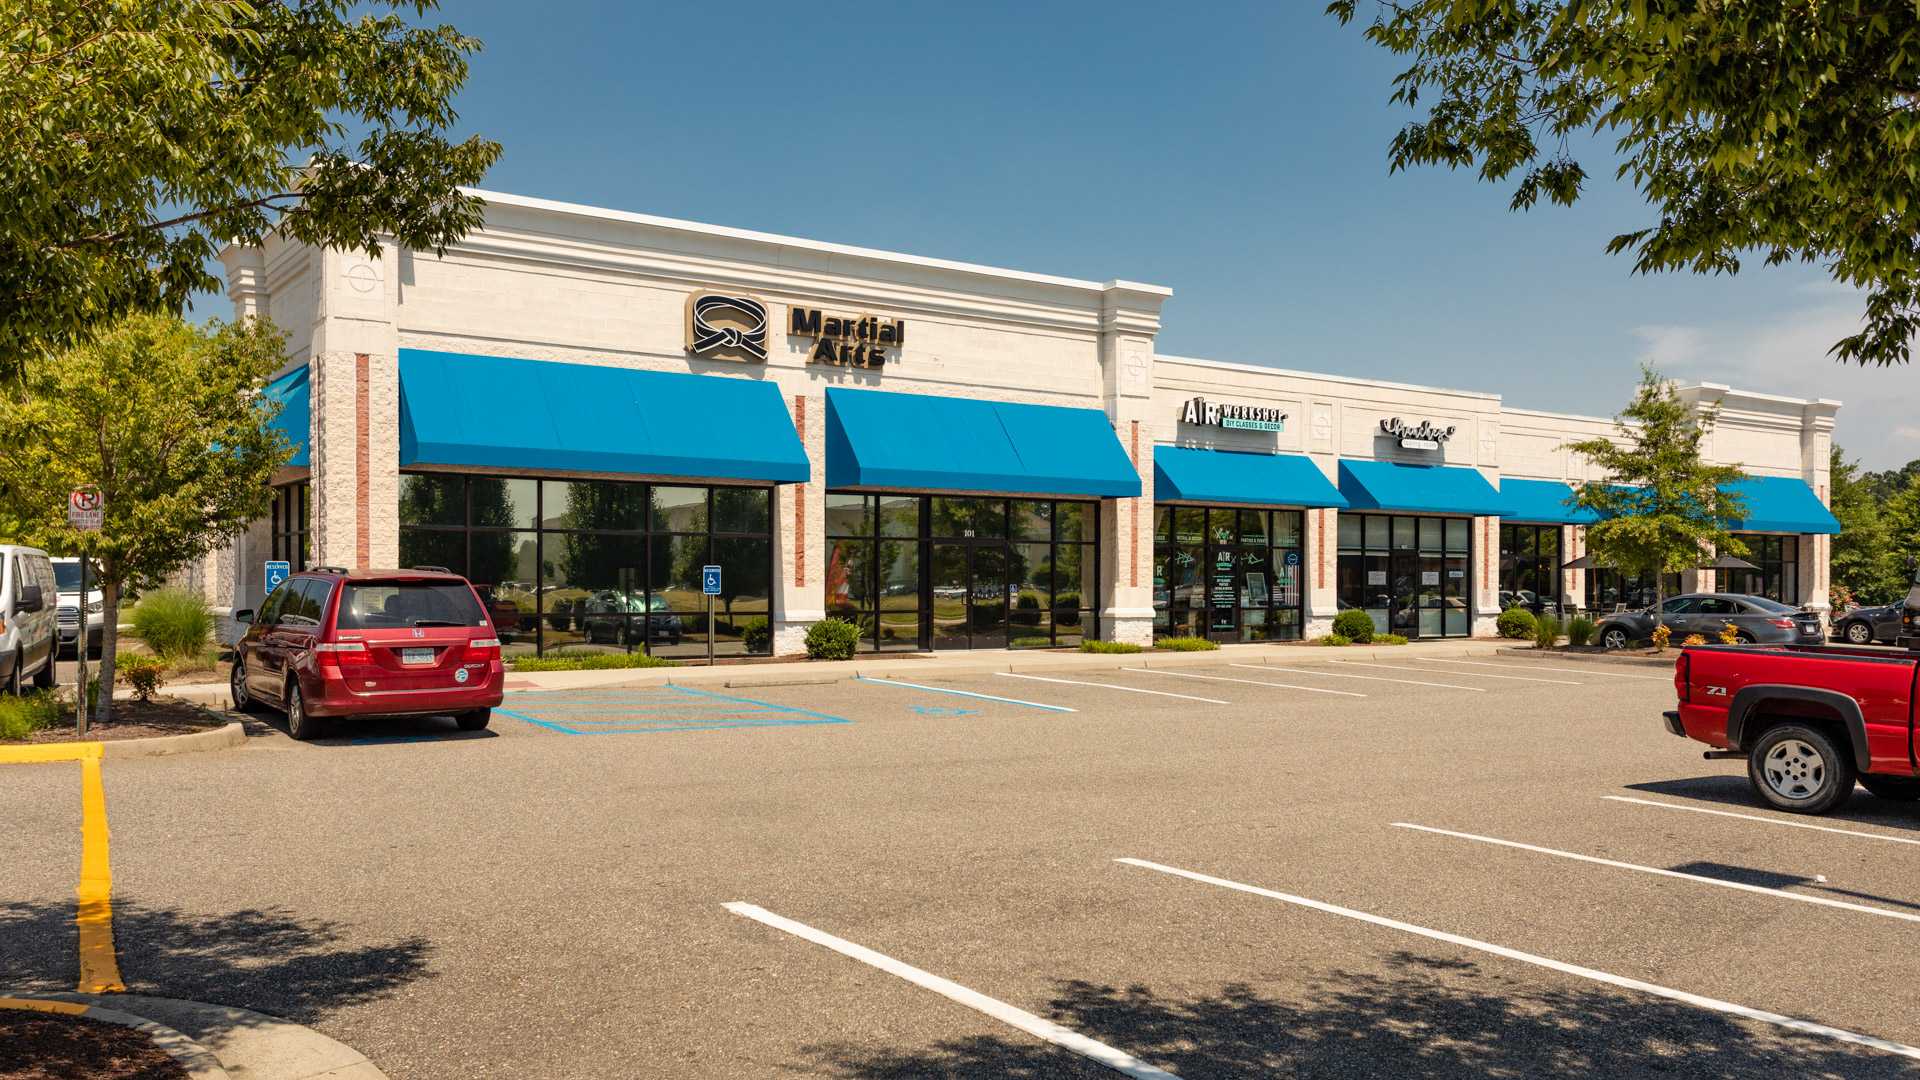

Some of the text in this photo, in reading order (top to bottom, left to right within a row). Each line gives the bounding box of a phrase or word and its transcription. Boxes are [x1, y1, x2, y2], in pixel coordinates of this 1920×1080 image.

[792, 307, 904, 343] Martial
[813, 337, 886, 366] Arts
[1223, 404, 1284, 421] WORKSHOP
[1226, 419, 1235, 427] DIY
[1236, 420, 1257, 429] CLASSES
